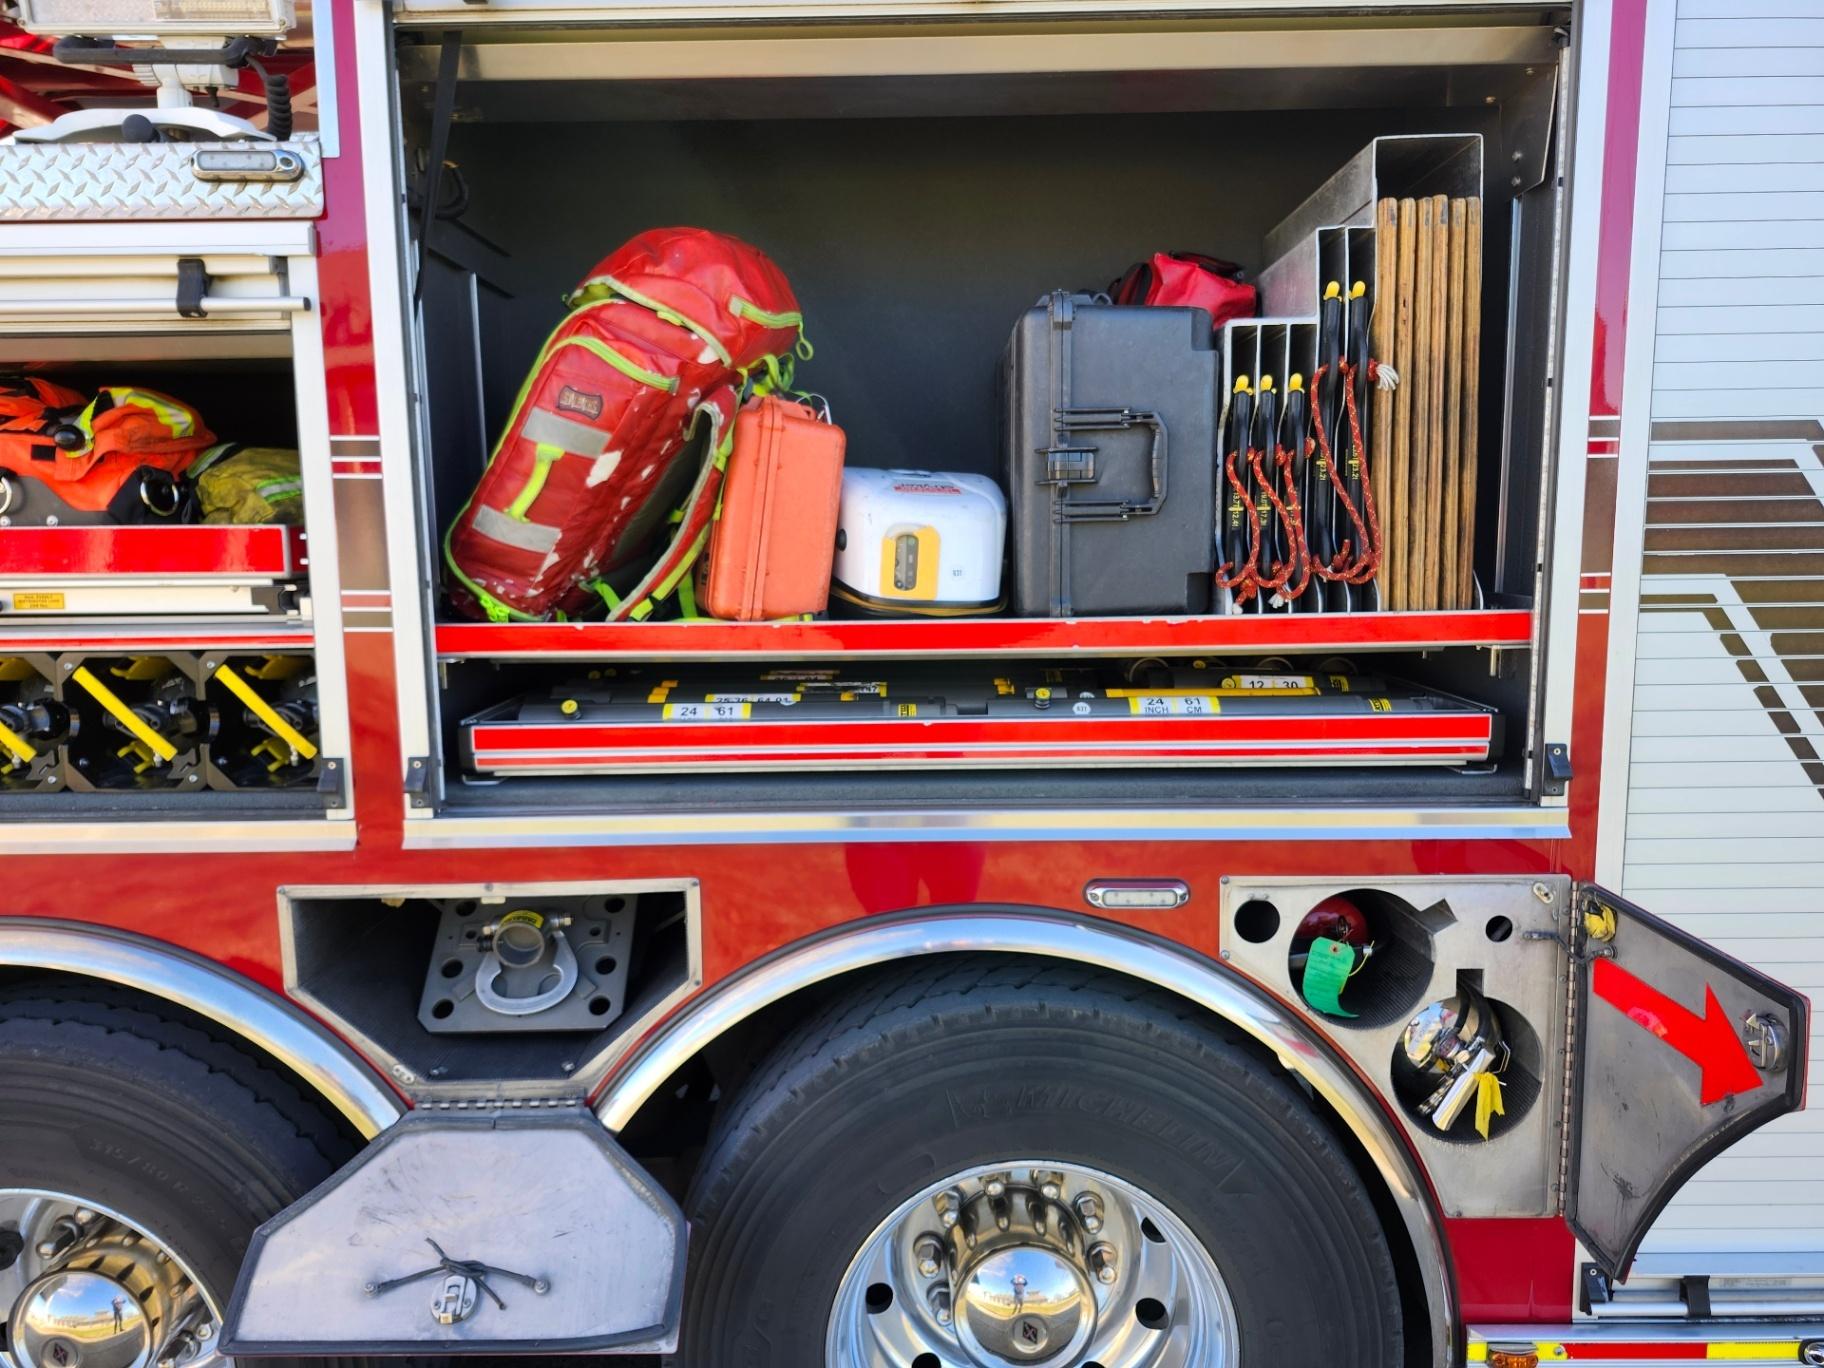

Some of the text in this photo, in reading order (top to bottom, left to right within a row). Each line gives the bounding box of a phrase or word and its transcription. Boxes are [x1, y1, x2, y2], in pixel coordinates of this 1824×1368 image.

[1249, 680, 1264, 688] 12
[1146, 697, 1201, 706] 24 61
[680, 706, 734, 716] 24 61
[1144, 706, 1202, 714] INCH CM
[1017, 1081, 1234, 1171] MICHELIN
